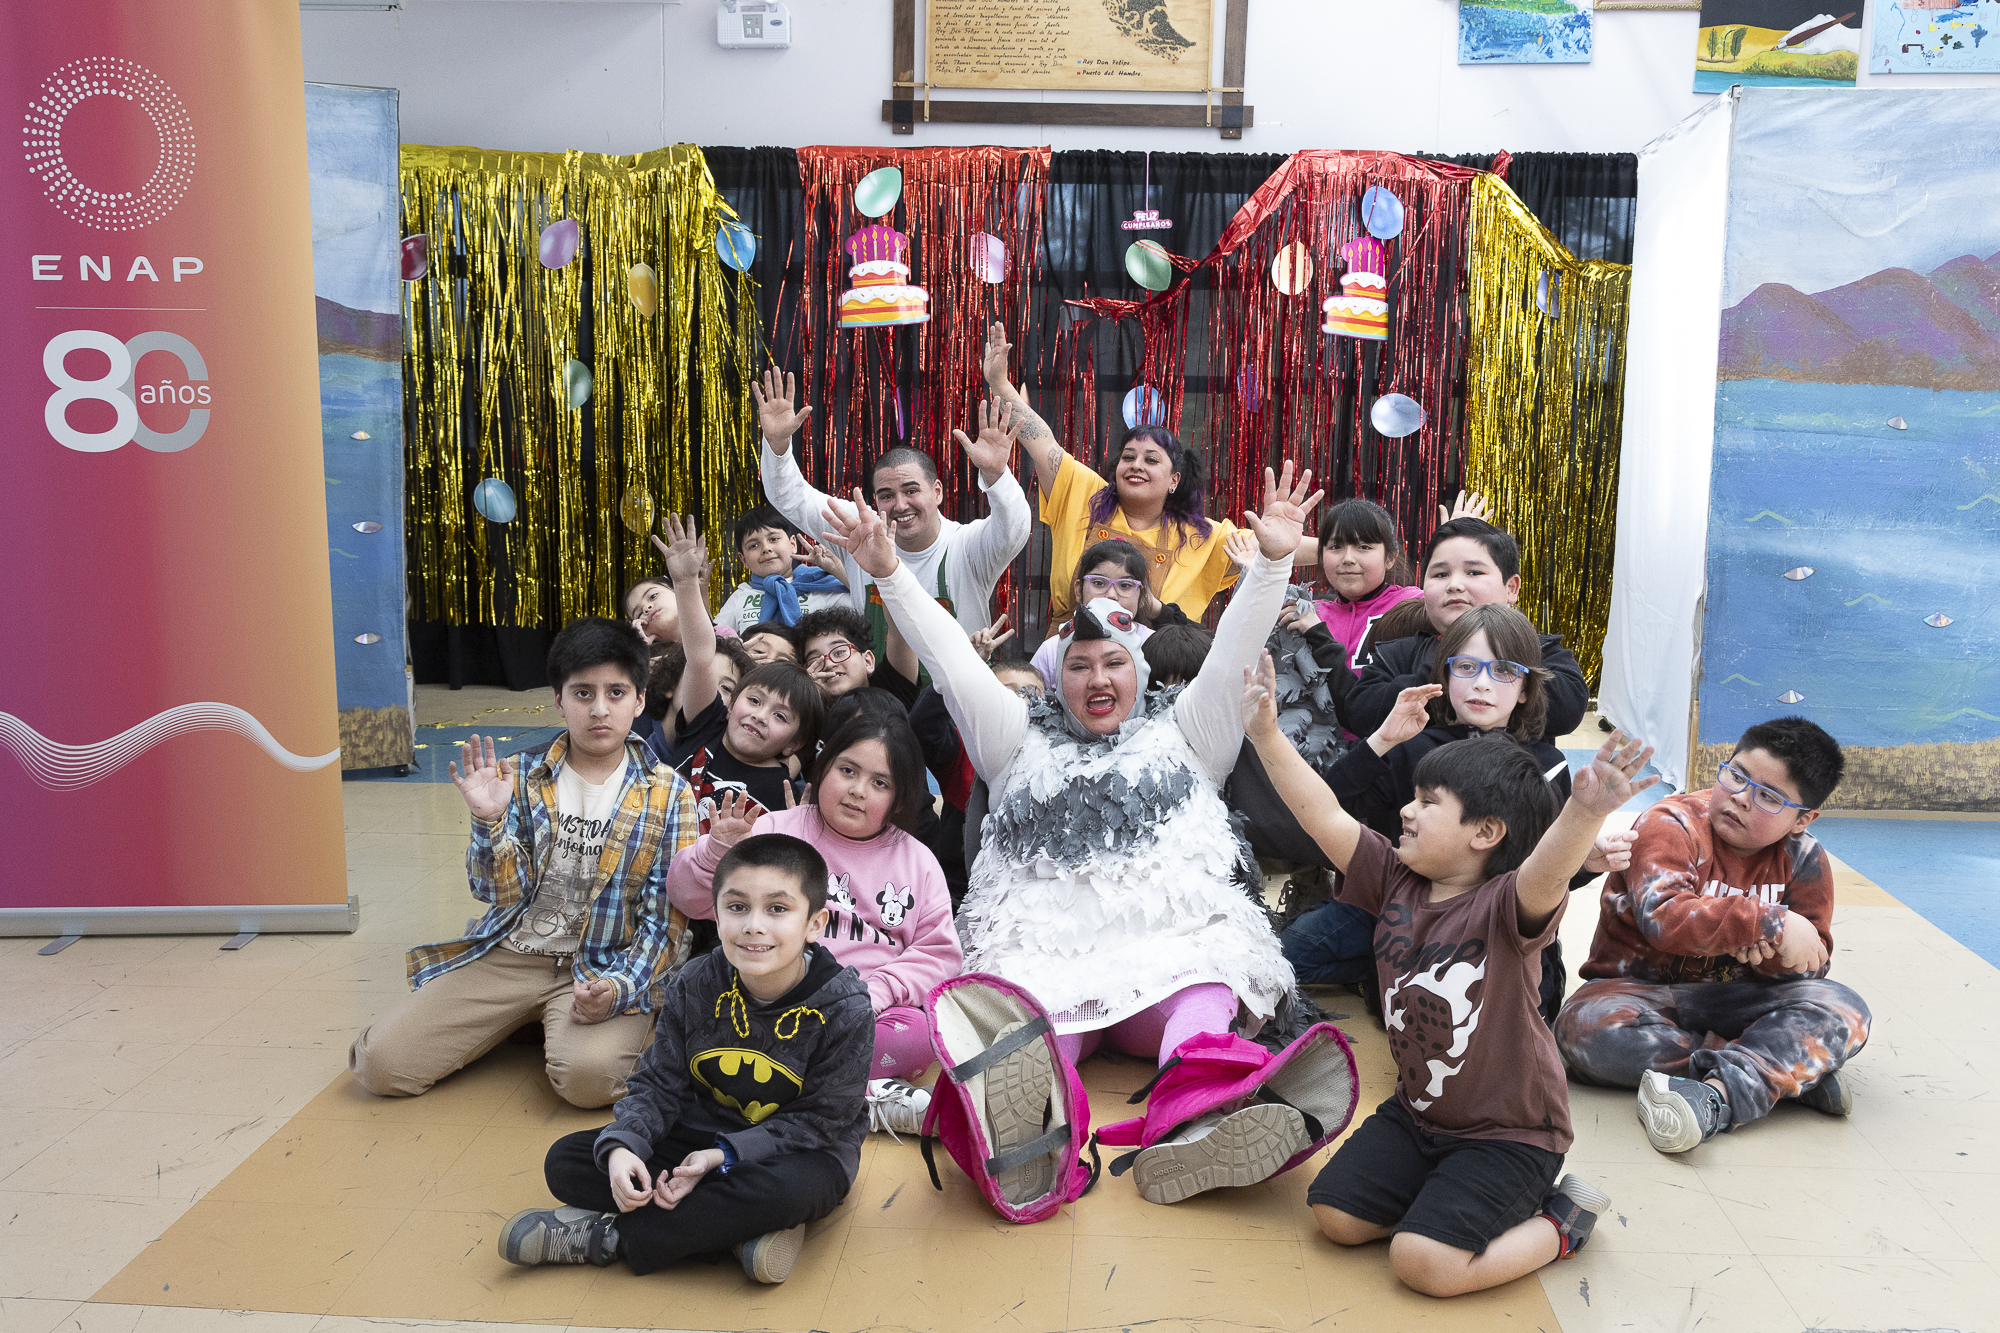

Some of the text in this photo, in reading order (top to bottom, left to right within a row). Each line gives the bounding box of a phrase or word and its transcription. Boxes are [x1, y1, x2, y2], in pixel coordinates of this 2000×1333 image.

[1135, 211, 1158, 222] FELIZ
[32, 254, 204, 282] ENAP
[140, 379, 212, 404] años
